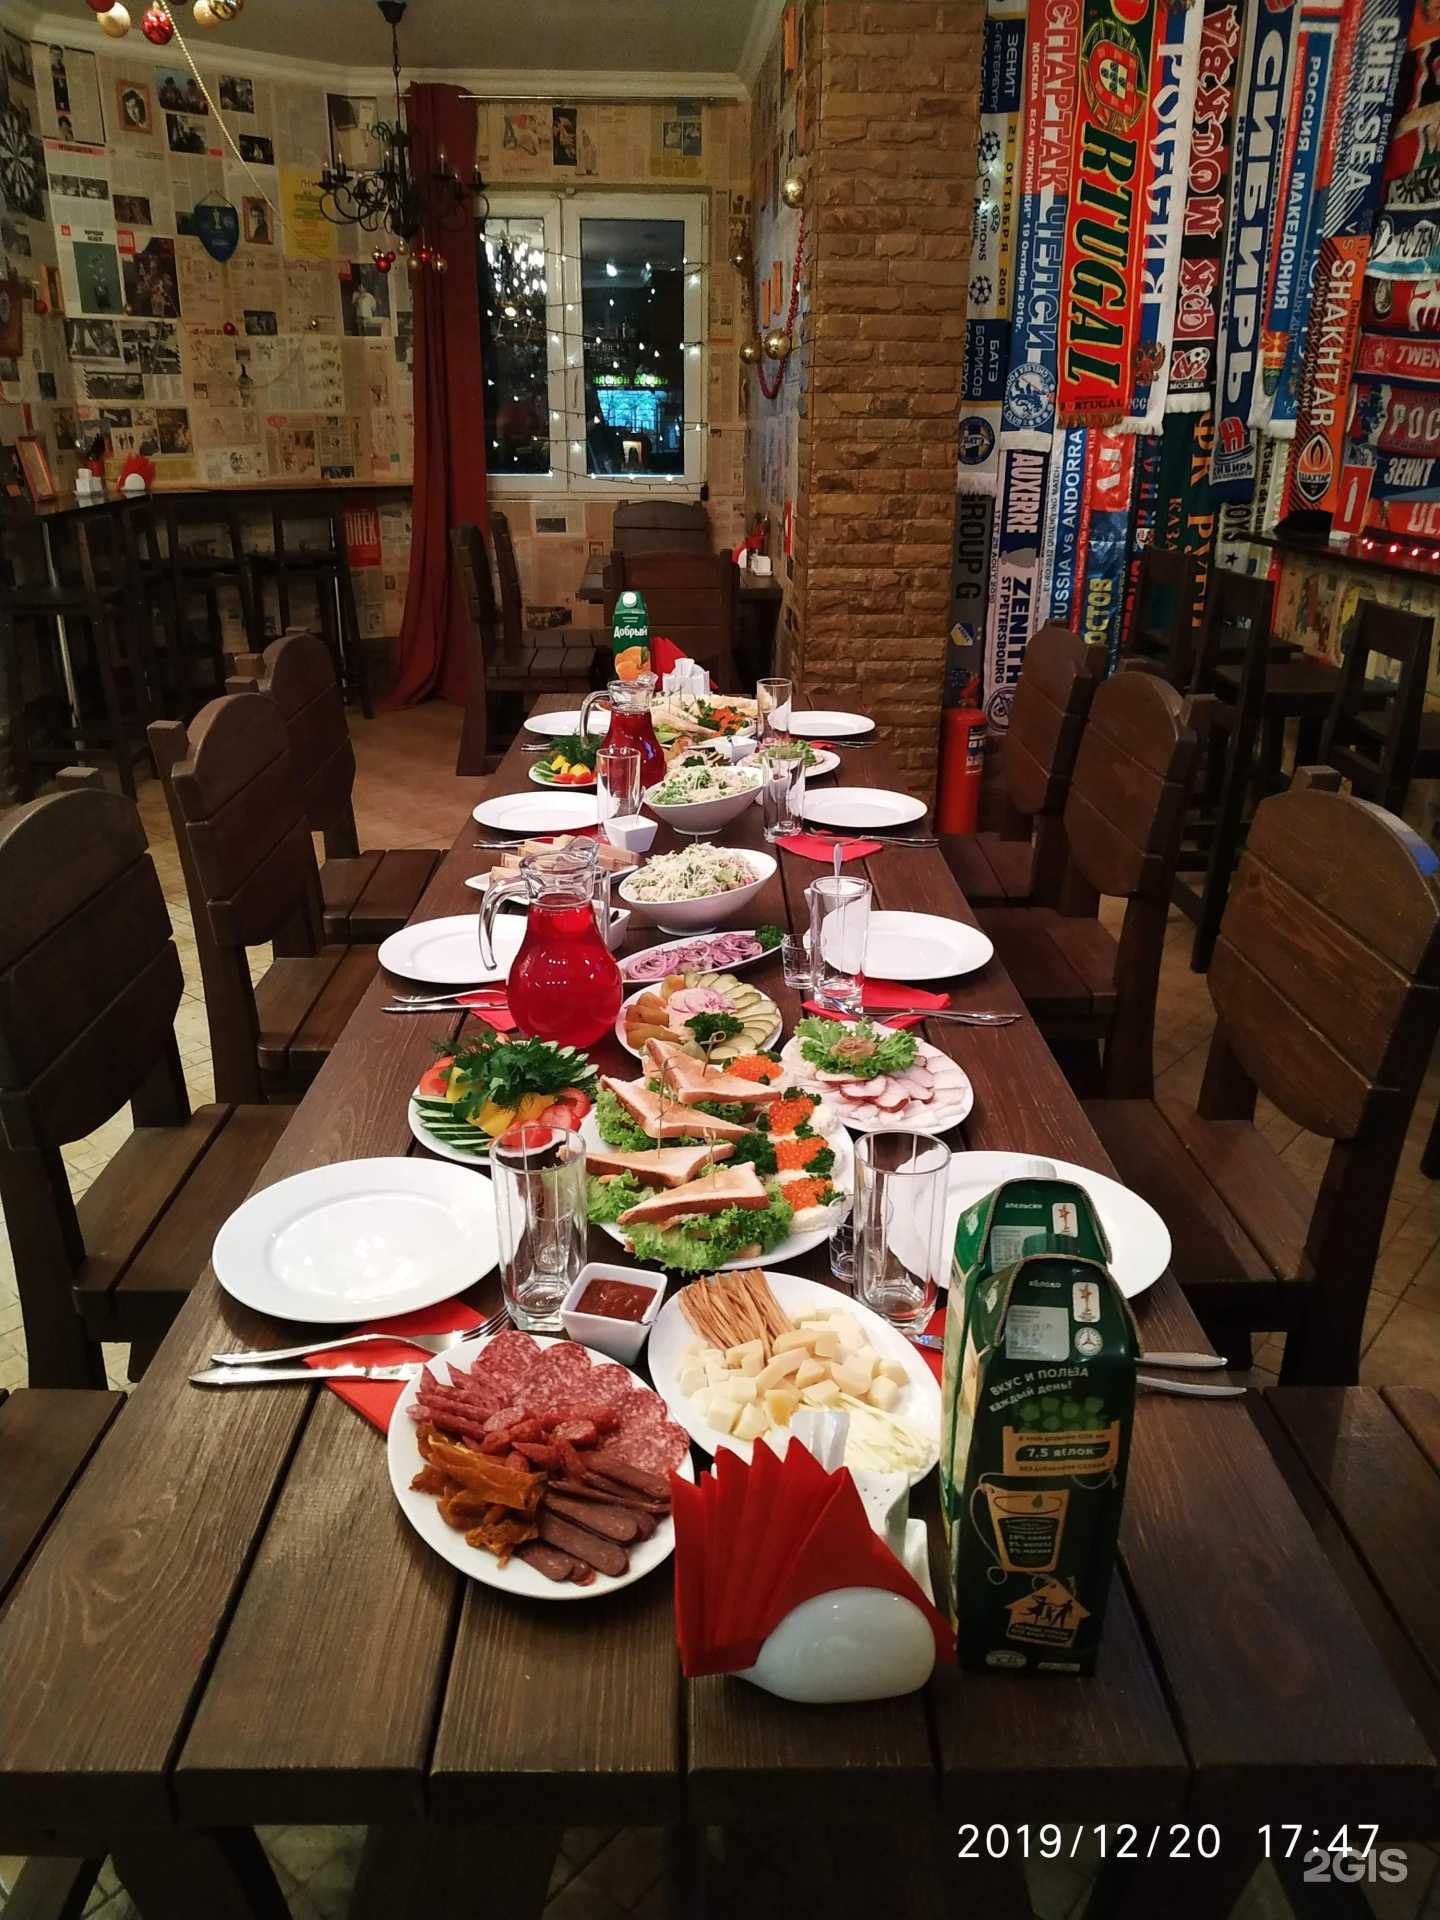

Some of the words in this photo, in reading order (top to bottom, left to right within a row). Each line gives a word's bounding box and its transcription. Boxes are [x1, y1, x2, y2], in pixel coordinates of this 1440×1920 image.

[1004, 32, 1019, 97] ЗЕНИТ
[1031, 42, 1041, 100] МОСКВА
[1037, 0, 1080, 191] СПАРТАК
[1185, 5, 1240, 239] МОСКВА
[1297, 56, 1321, 152] РОССИЯ
[1344, 16, 1400, 193] CHELSEA
[1376, 113, 1392, 163] Bridge
[1001, 162, 1014, 251] ОКТЯБРЯ
[1227, 30, 1283, 404] СИБИРЬ
[1274, 172, 1305, 309] МАКЕДОНИЯ
[998, 268, 1008, 306] 2008
[1017, 241, 1029, 292] Октября
[1025, 204, 1067, 350] ЧЕЛСИ
[973, 325, 984, 397] БОРИСОВ
[988, 340, 999, 382] БАТЭ
[1310, 259, 1356, 426] SHAKHTAR
[1007, 453, 1044, 534] AUXERRE
[1052, 466, 1060, 496] MATCH
[1063, 430, 1083, 528] ANDORRA
[1384, 457, 1436, 487] ЗЕНИТ
[956, 583, 981, 600] G
[1001, 577, 1012, 592] ST
[613, 624, 649, 639] Добрый
[994, 594, 1010, 684] PETERSBOURG
[1006, 577, 1032, 684] ZENITH
[990, 1375, 1024, 1397] ВКУС
[1024, 1372, 1035, 1383] И
[1037, 1367, 1089, 1380] ПОЛЬЗА
[1038, 1380, 1072, 1396] день!
